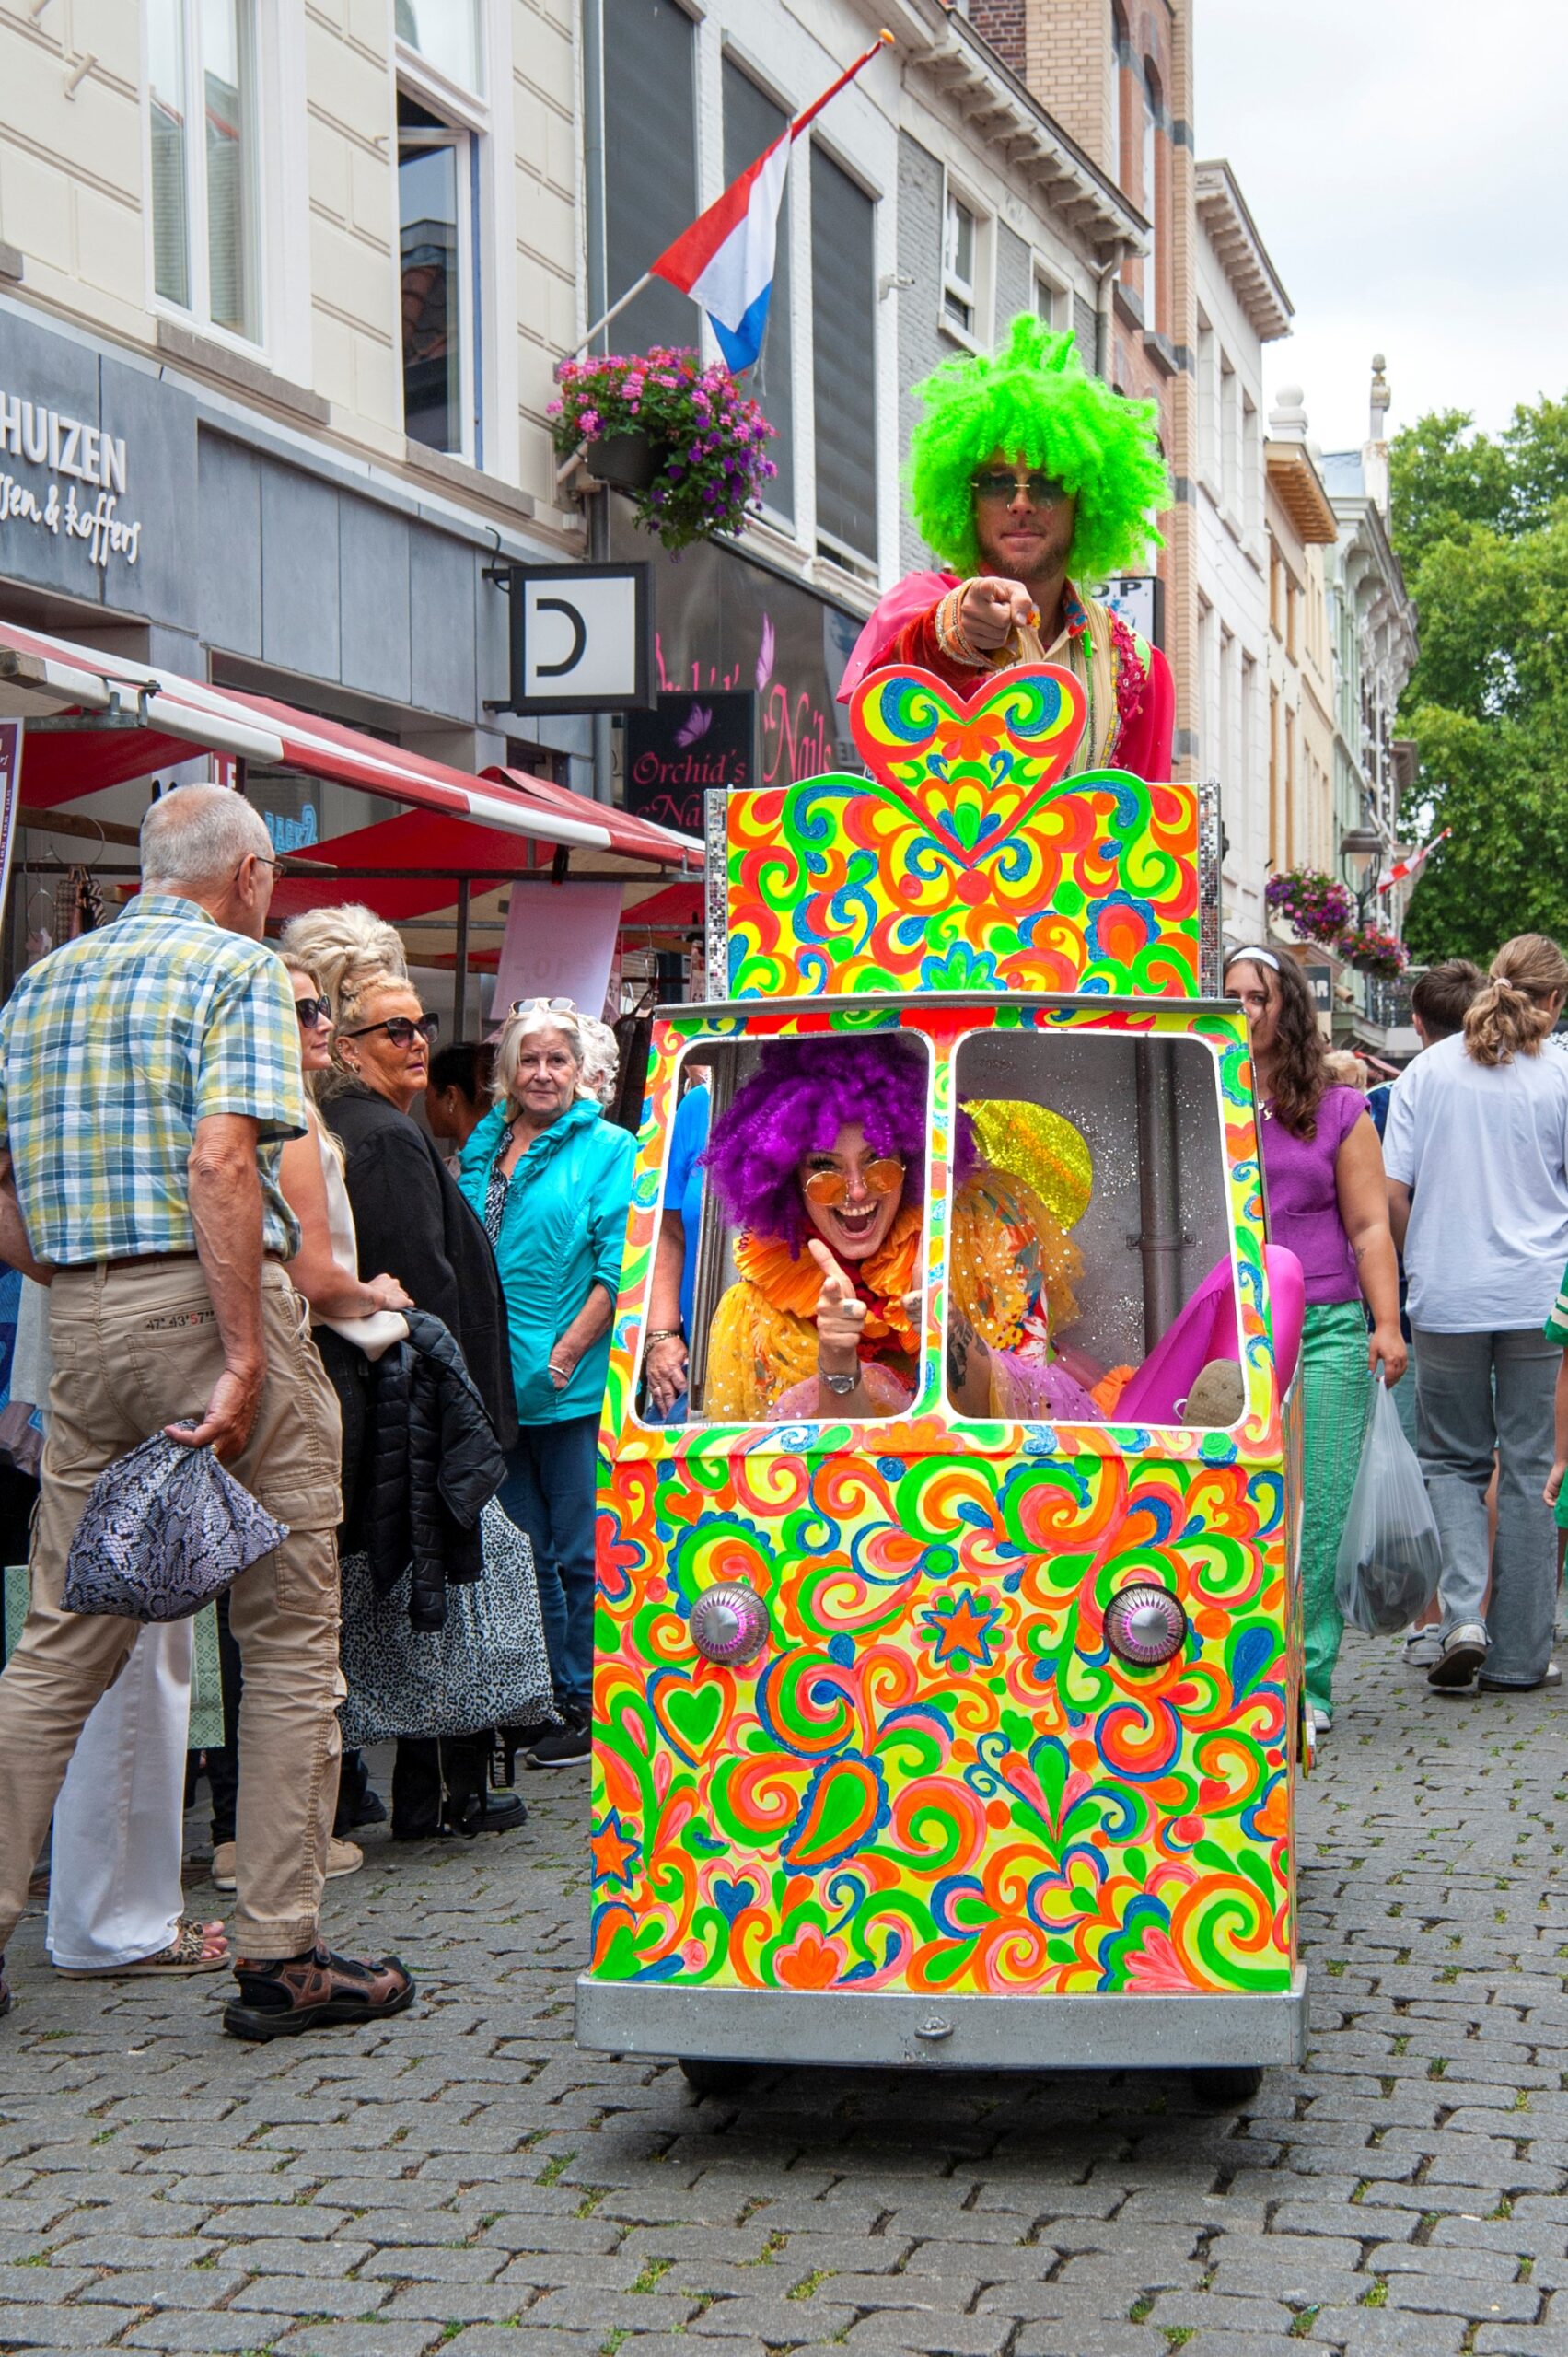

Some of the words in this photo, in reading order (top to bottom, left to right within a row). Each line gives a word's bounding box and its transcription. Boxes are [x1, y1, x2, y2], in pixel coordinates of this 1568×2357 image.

[0, 390, 126, 493] HUIZEN
[44, 484, 61, 534] &
[633, 749, 747, 784] Orchid's
